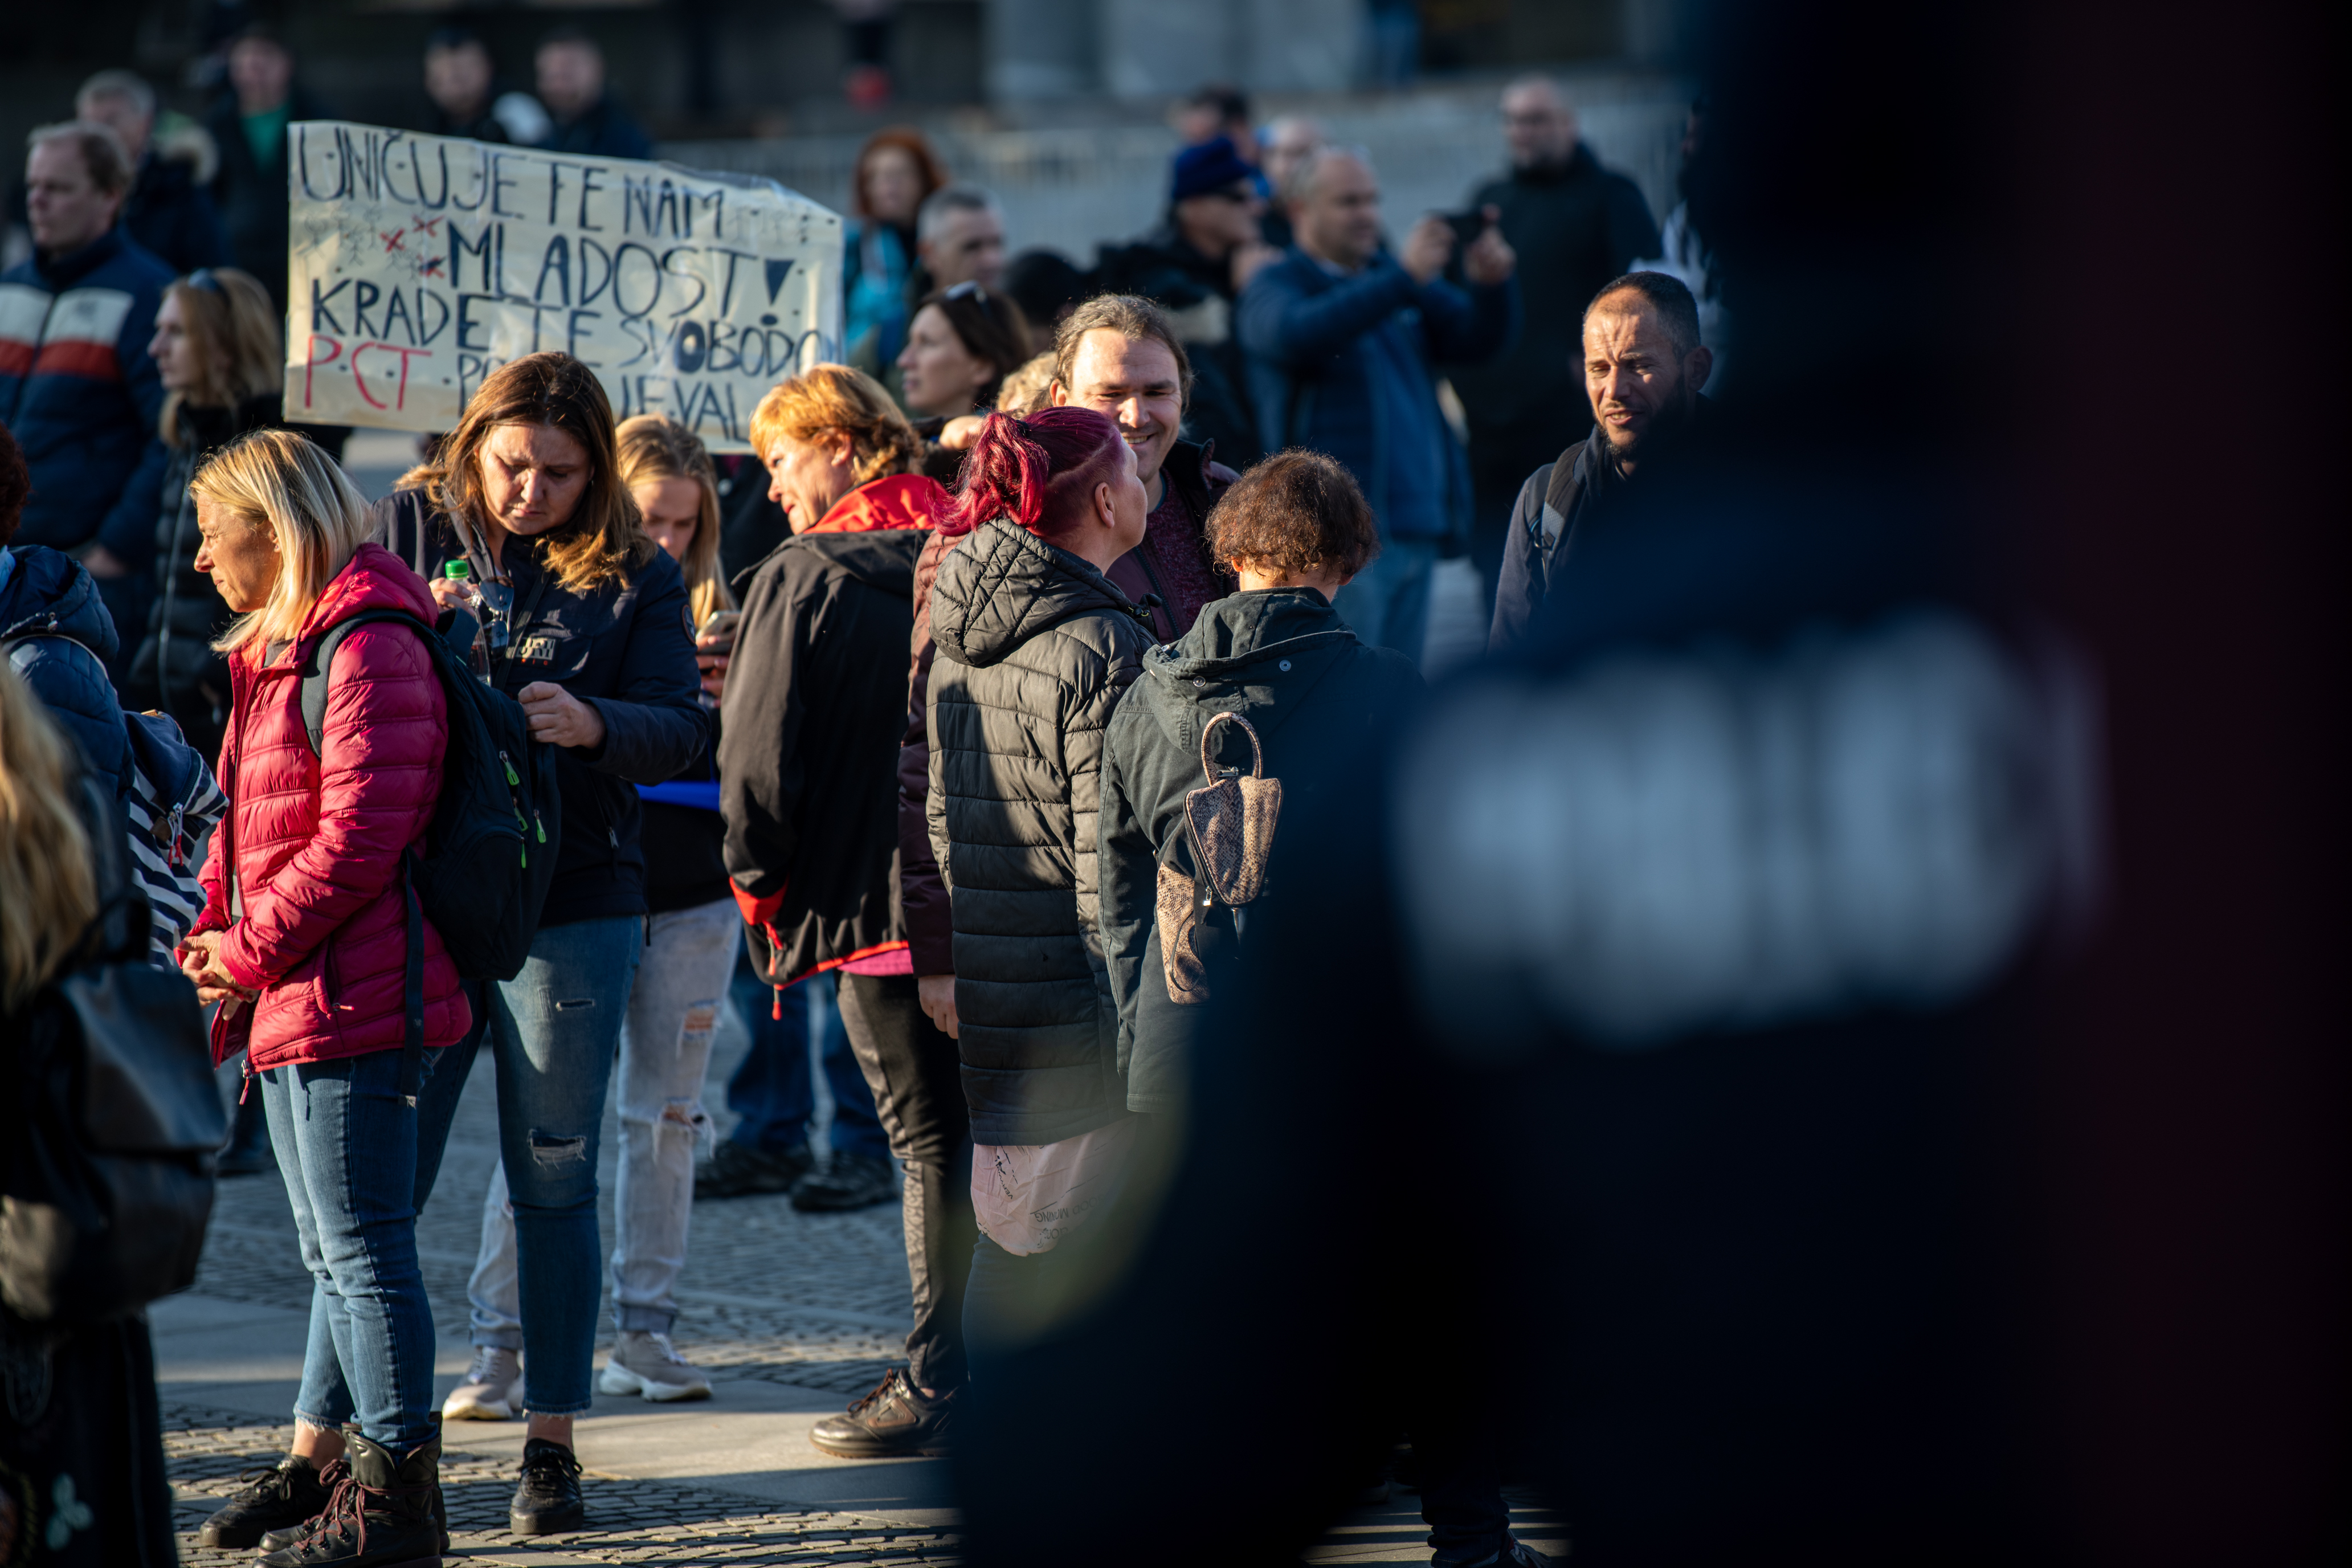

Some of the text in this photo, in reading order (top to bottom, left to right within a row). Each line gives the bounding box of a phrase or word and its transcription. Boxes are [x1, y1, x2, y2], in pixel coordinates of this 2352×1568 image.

[623, 174, 724, 240] NAM
[447, 218, 795, 326] MLADOST!
[311, 277, 602, 368] KRADETE
[304, 334, 433, 411] PCT
